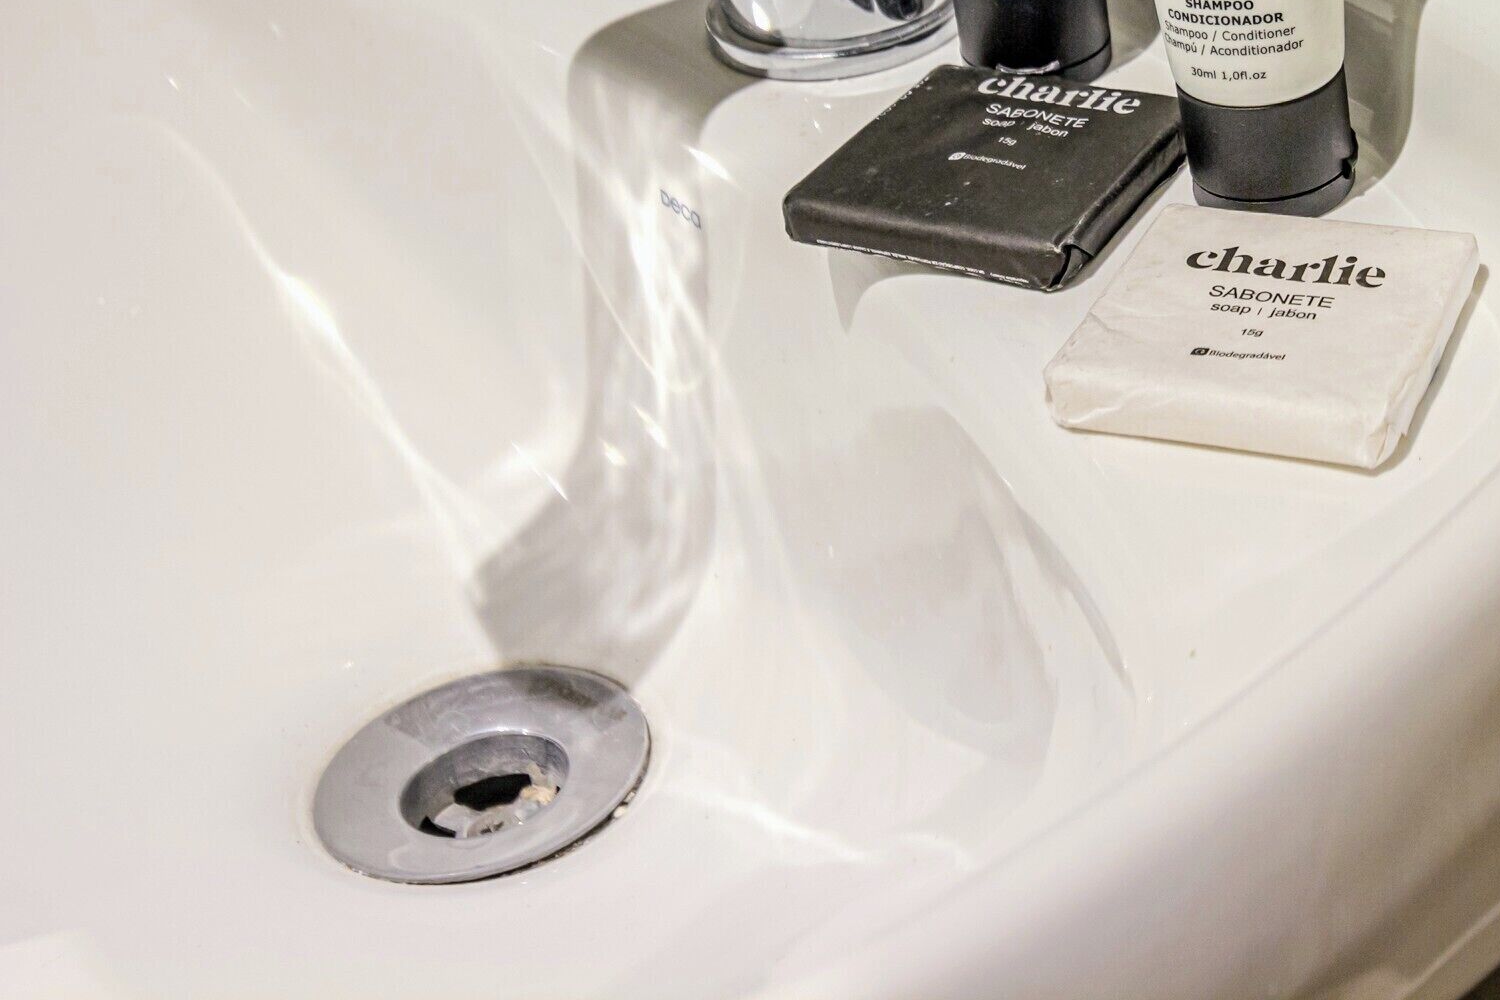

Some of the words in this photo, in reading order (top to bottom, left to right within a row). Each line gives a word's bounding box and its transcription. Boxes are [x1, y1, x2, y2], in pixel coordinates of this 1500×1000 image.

[1168, 8, 1284, 26] CONDICIONADOR
[1164, 20, 1208, 42] Shampoo
[1211, 30, 1217, 42] /
[1222, 25, 1296, 42] Conditioner
[1164, 32, 1197, 53] Champú
[1209, 38, 1304, 57] Aconditionador
[1191, 66, 1216, 80] 30ml
[977, 76, 1141, 115] charlie
[982, 118, 1016, 128] soap
[985, 103, 1089, 128] SABONETE
[998, 136, 1017, 146] 15g
[1186, 246, 1386, 289] charlie
[1209, 285, 1335, 309] SABONETE
[1210, 303, 1251, 316] soap
[1241, 328, 1264, 338] 15g
[1209, 350, 1286, 361] Biodegradável
